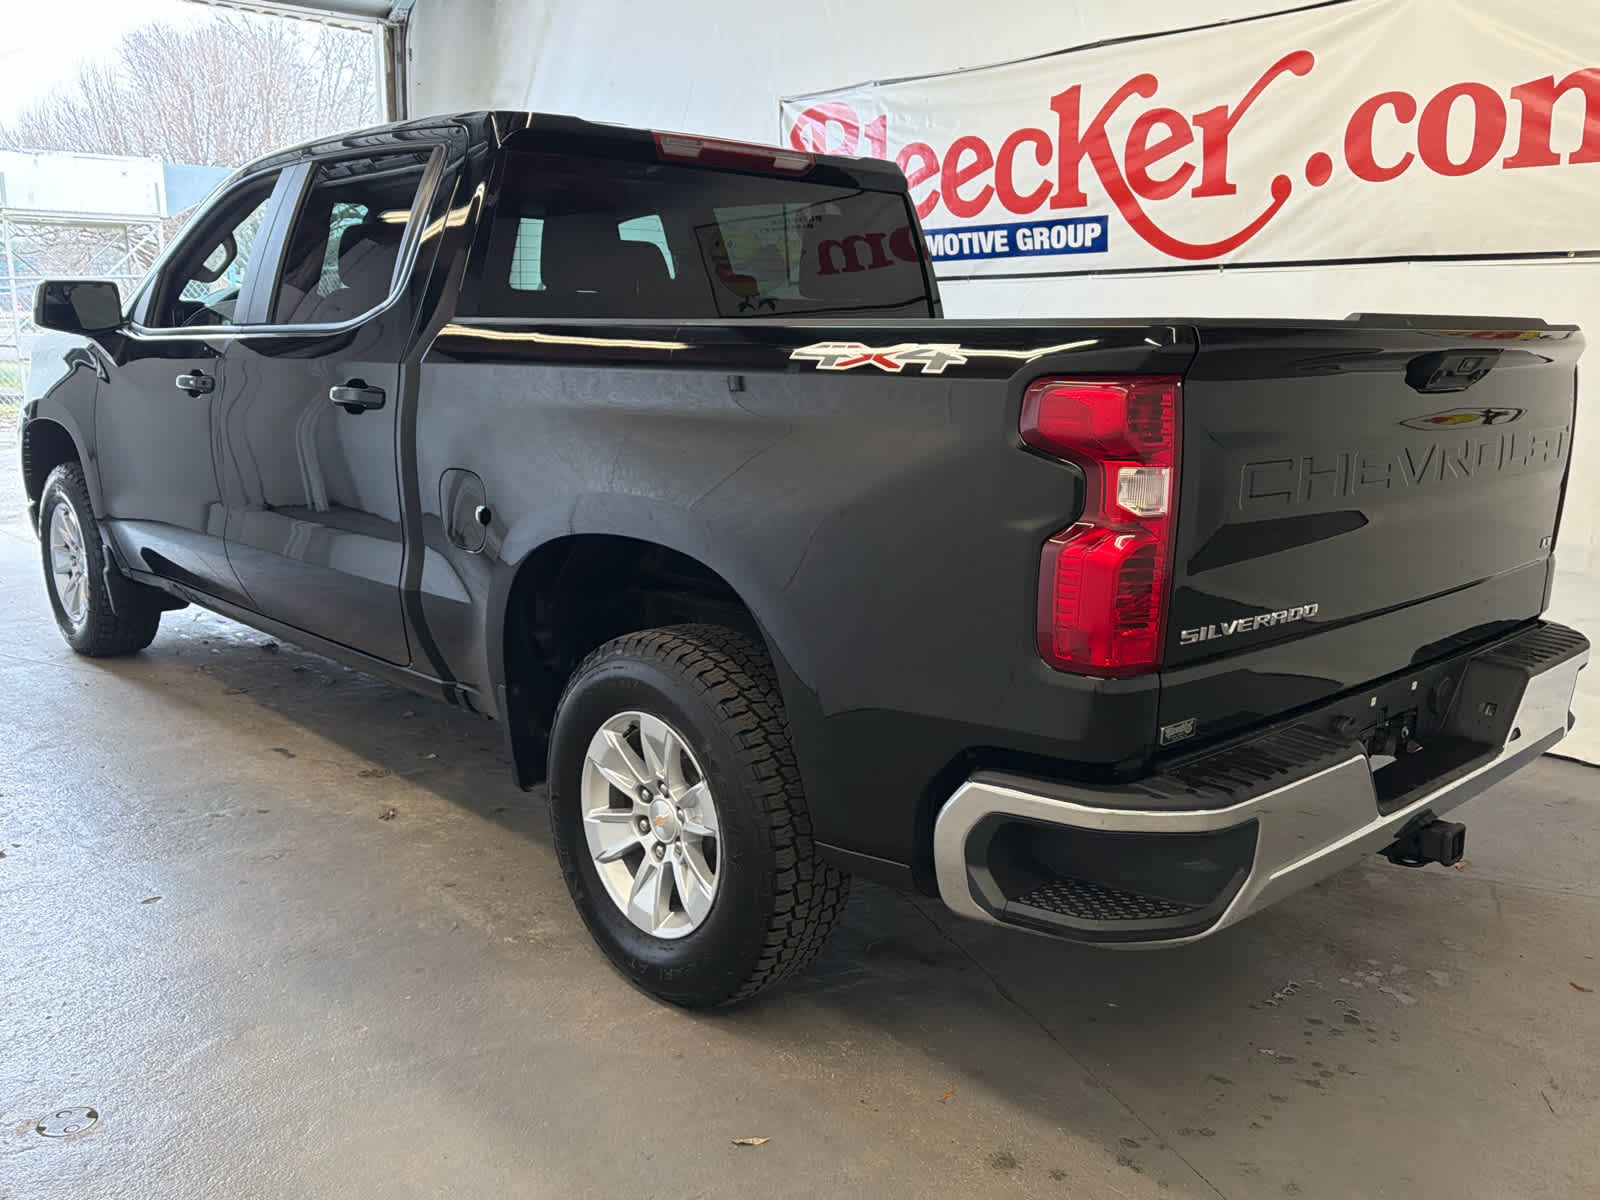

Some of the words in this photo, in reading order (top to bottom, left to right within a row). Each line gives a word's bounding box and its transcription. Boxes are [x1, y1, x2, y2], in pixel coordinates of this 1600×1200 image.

[926, 229, 1010, 257] MOTIVE
[1016, 223, 1102, 251] GROUP
[1239, 426, 1569, 509] CHEVROLET
[1179, 603, 1320, 646] SILVERADO
